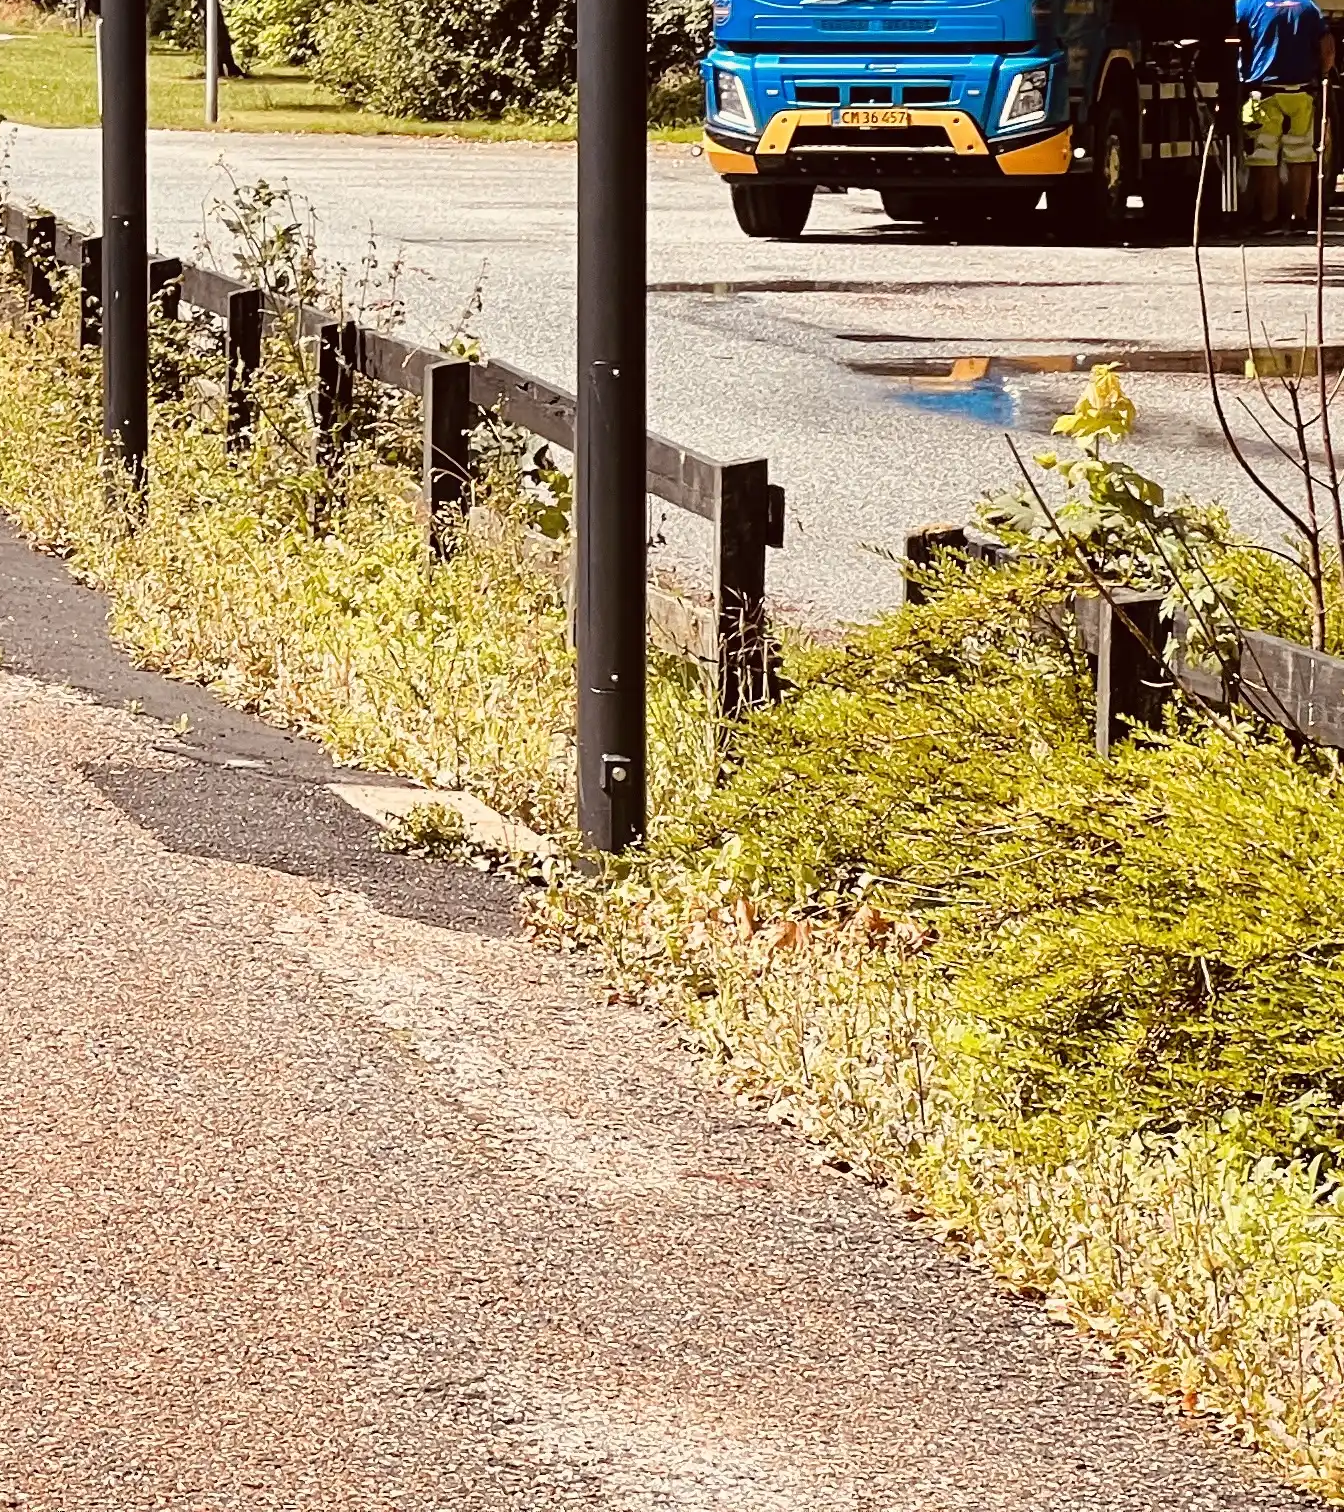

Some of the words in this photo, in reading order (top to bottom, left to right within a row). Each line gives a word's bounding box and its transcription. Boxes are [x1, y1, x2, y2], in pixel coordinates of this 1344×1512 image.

[842, 112, 859, 124] CM
[863, 112, 878, 124] 36
[882, 112, 905, 124] 457
